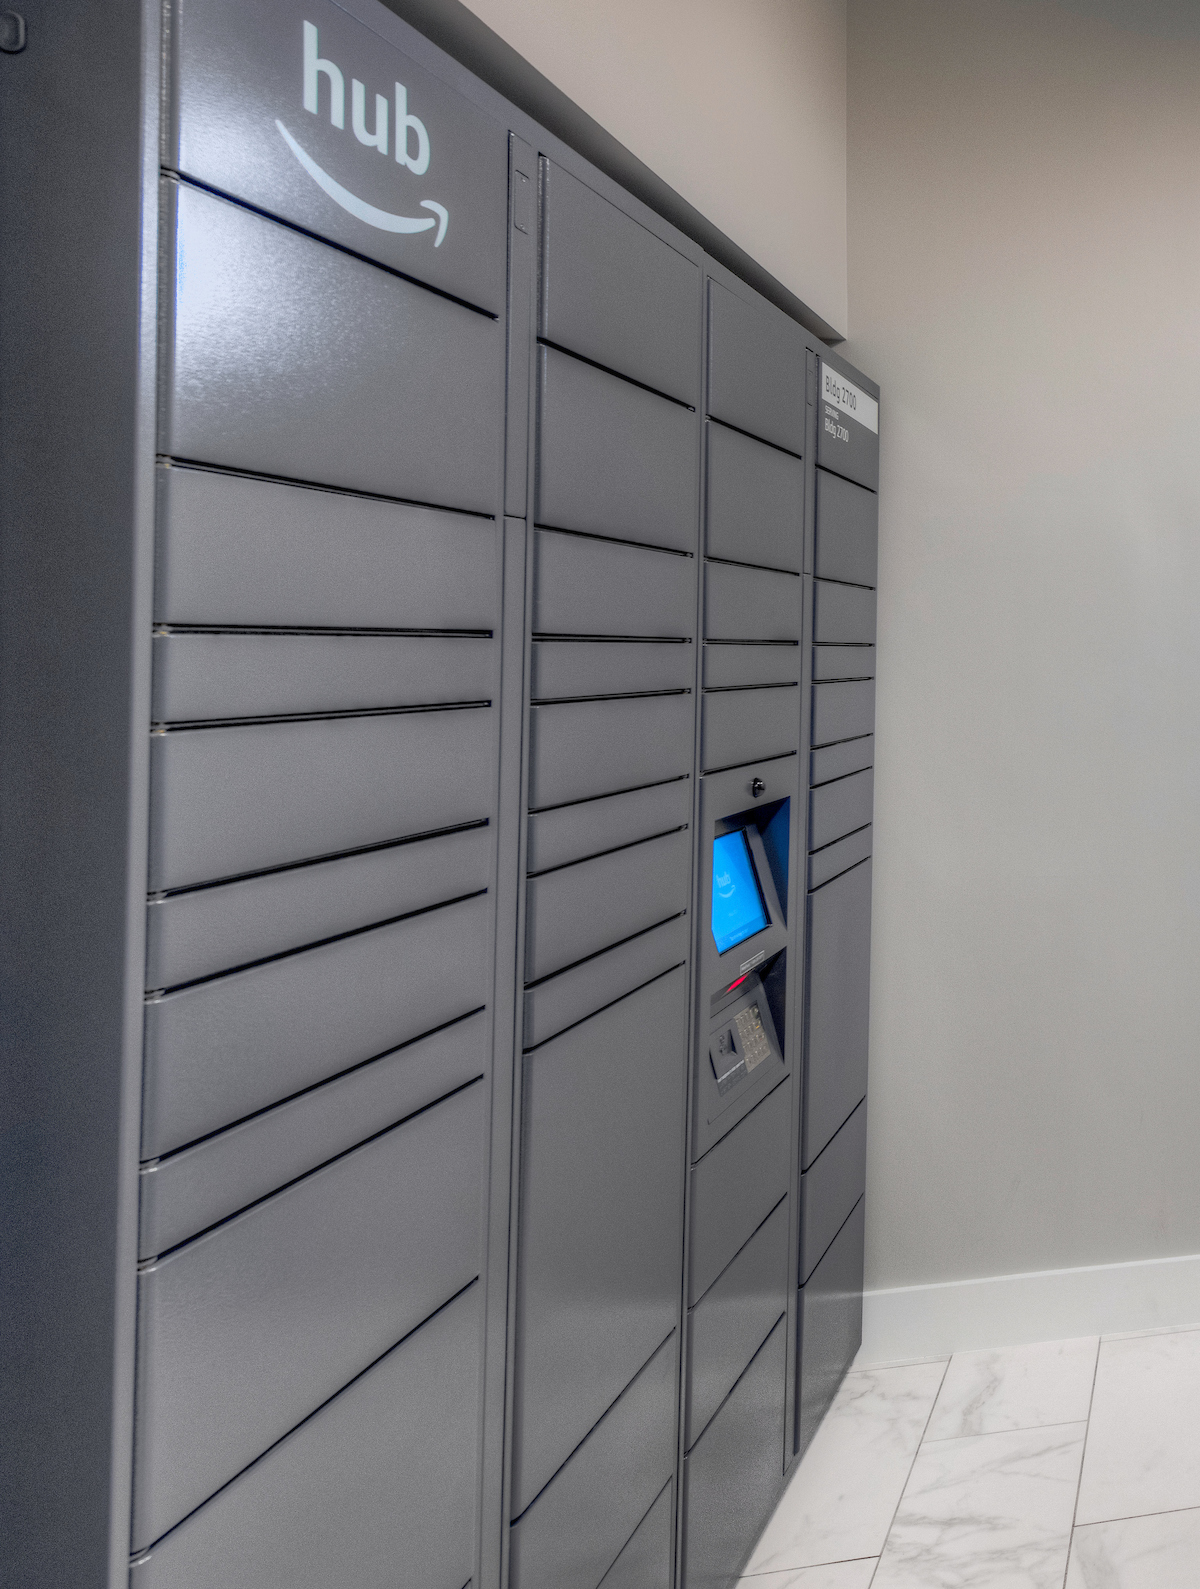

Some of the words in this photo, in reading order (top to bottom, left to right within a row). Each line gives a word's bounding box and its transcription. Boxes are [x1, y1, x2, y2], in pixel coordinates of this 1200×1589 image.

[303, 20, 430, 175] hub
[826, 375, 840, 404] Bldg
[842, 386, 856, 410] 2700
[824, 418, 836, 438] Bldg
[837, 424, 849, 442] 2700
